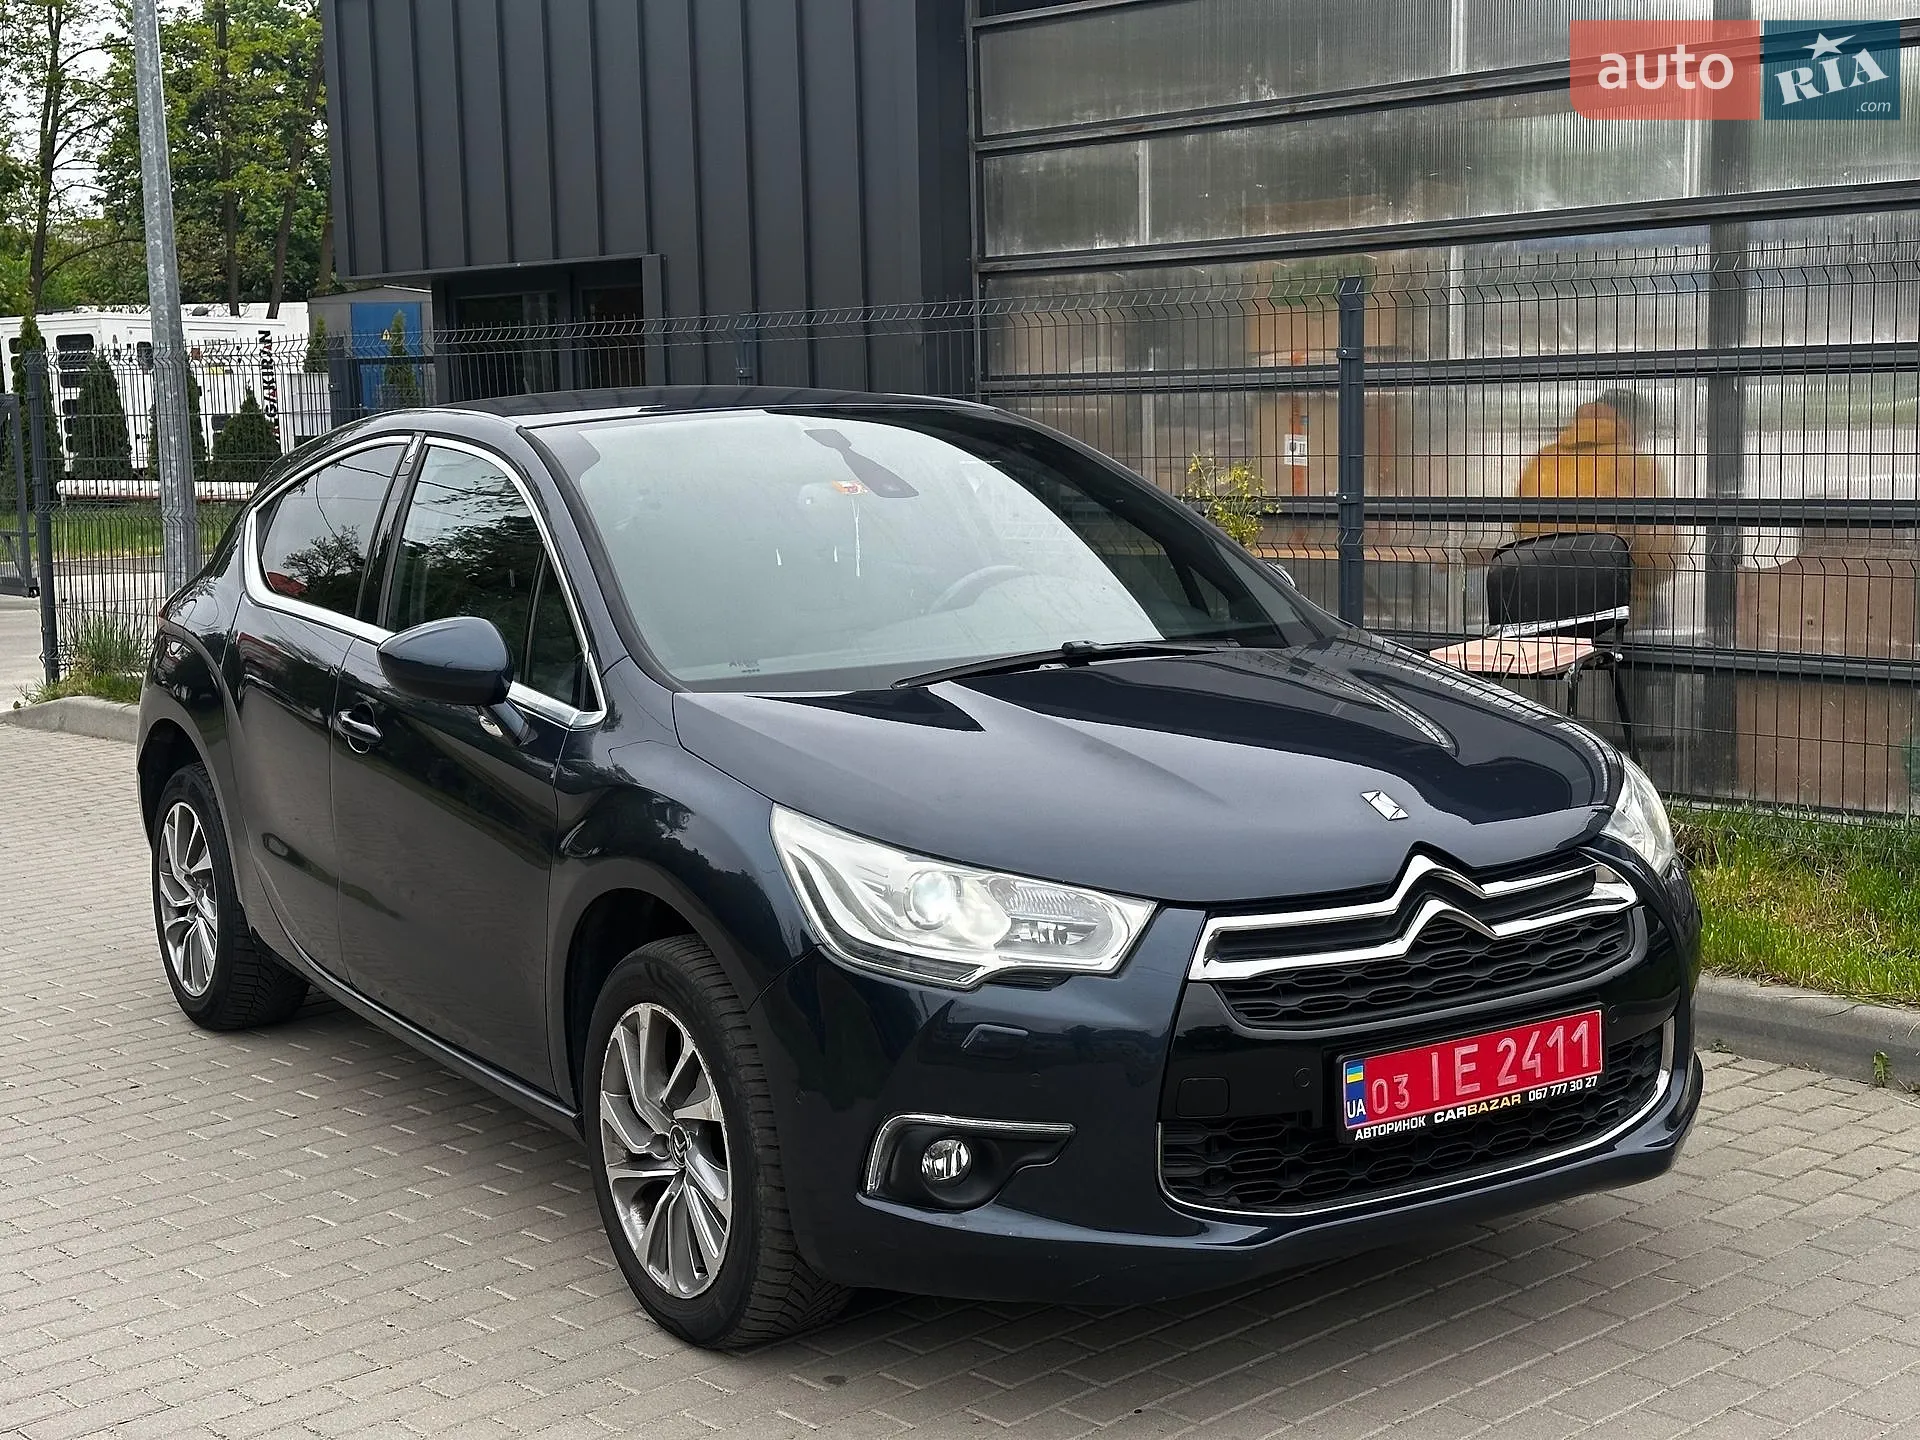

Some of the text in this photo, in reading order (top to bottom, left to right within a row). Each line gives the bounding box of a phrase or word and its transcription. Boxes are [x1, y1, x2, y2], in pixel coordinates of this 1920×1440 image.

[1371, 1020, 1589, 1115] 03 IE 2411
[1346, 1098, 1366, 1119] UA
[1354, 1075, 1598, 1141] АВТОРИНОК CARBAZAR 067 777 30 27
